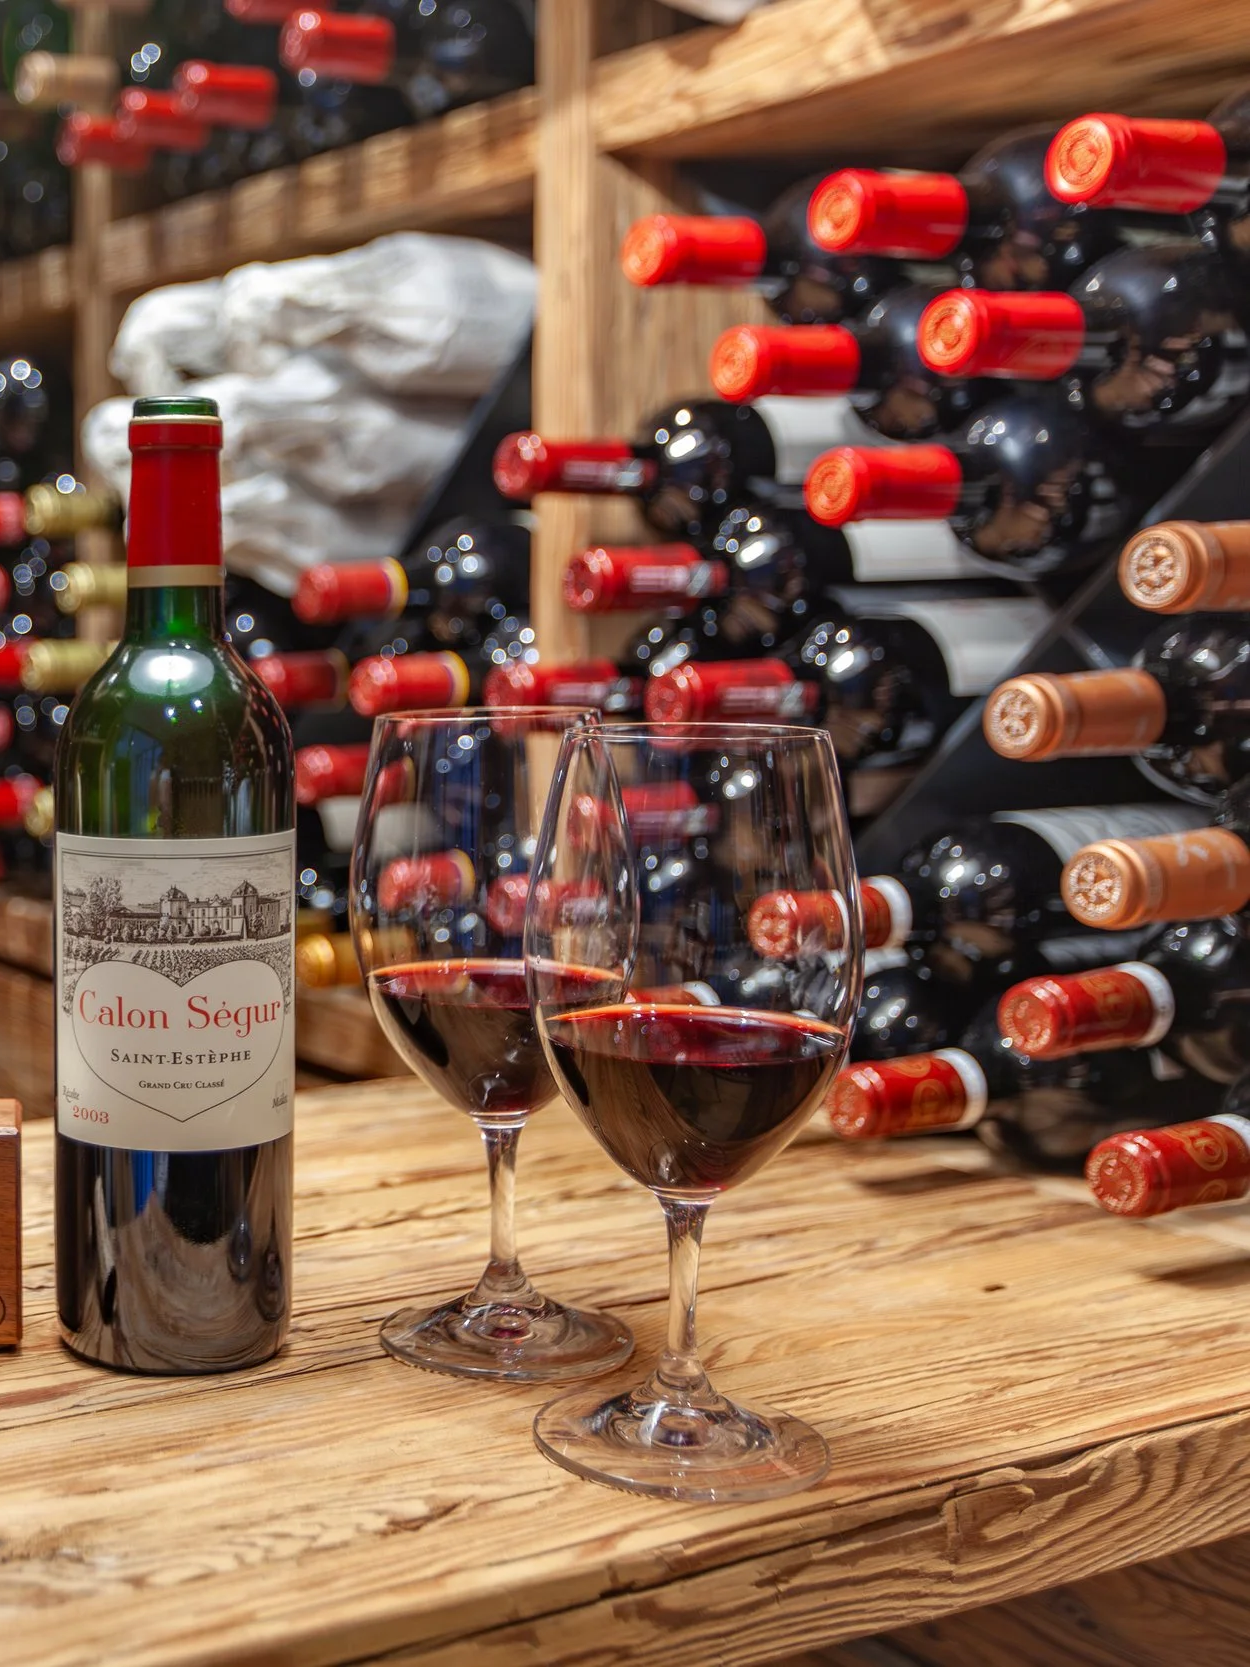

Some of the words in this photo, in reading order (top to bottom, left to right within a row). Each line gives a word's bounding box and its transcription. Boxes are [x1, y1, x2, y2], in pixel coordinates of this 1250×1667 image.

[79, 989, 170, 1030] Calon
[186, 995, 281, 1038] Ségur
[110, 1048, 252, 1066] SAINT-ESTÈPHE
[138, 1079, 171, 1090] GRAND
[173, 1080, 193, 1090] CRU
[194, 1078, 226, 1089] CLASSÉ
[72, 1104, 110, 1125] 2003
